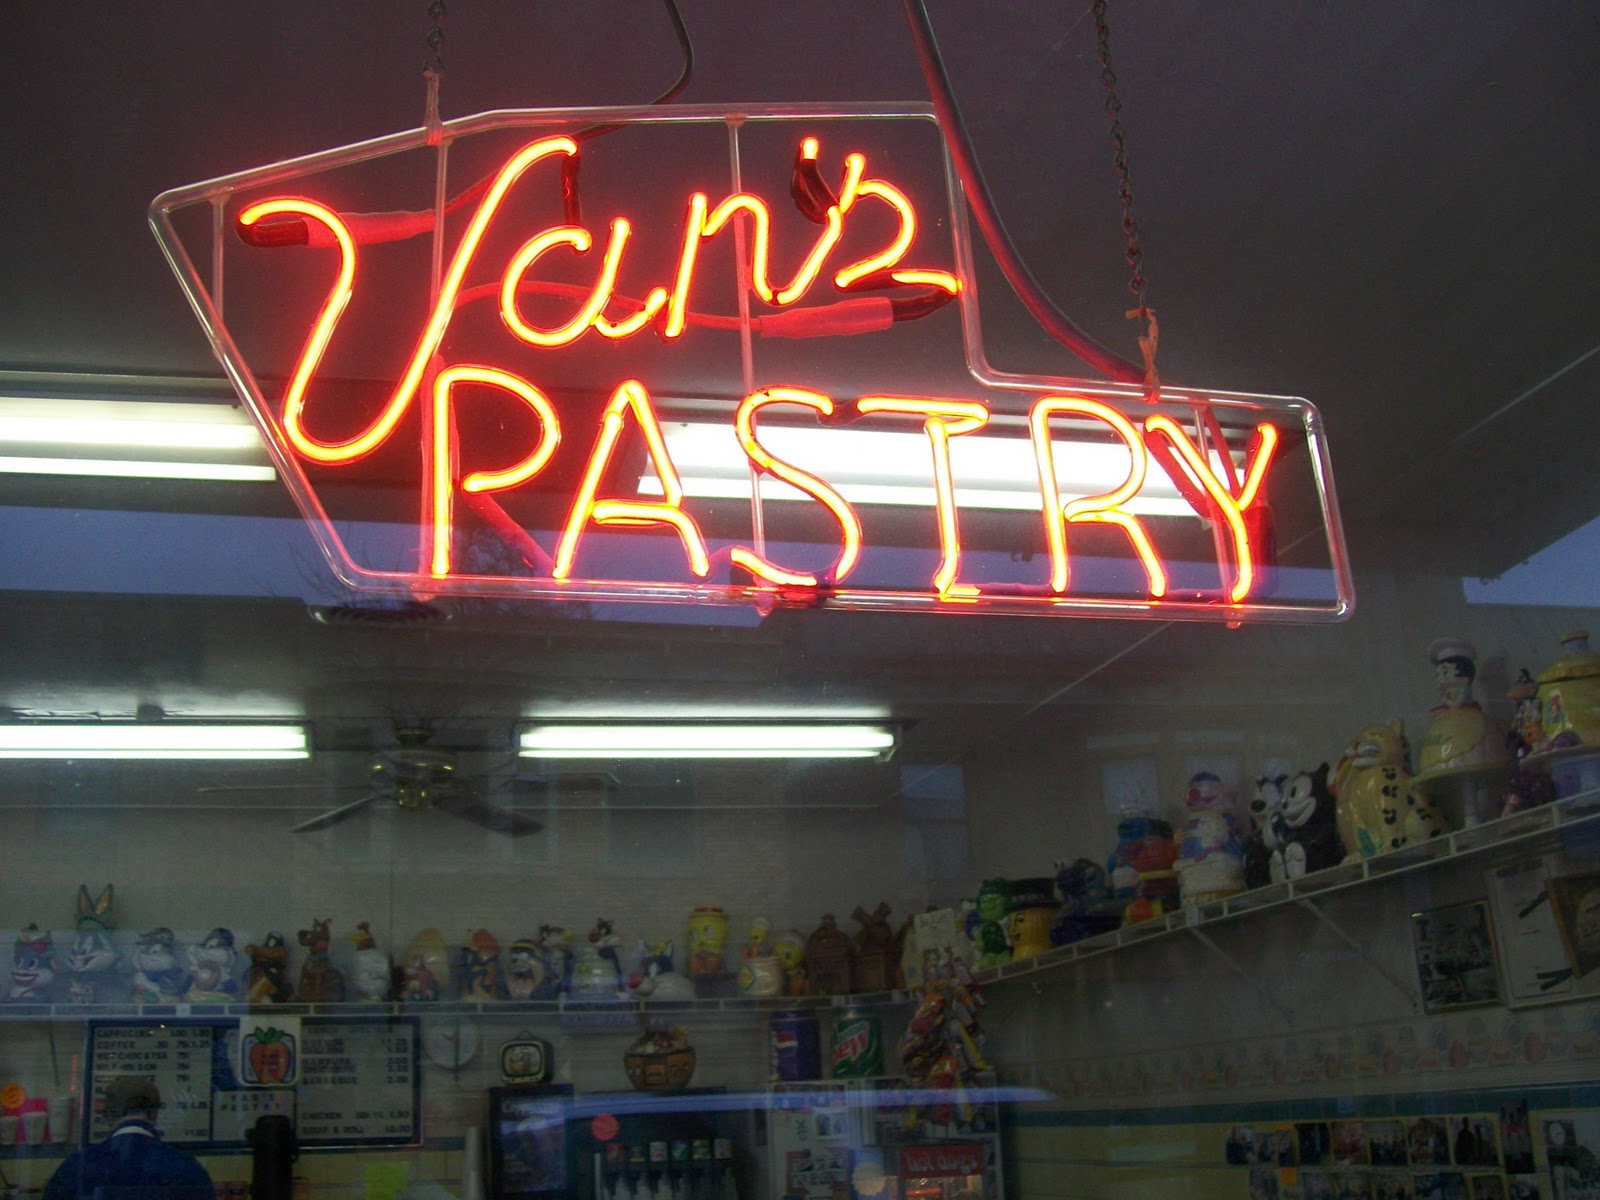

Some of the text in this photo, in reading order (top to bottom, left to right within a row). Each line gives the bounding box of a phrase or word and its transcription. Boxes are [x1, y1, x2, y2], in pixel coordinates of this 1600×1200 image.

[236, 134, 964, 466] Van's
[431, 364, 1280, 605] PASTRY
[97, 1040, 136, 1049] COFFEE
